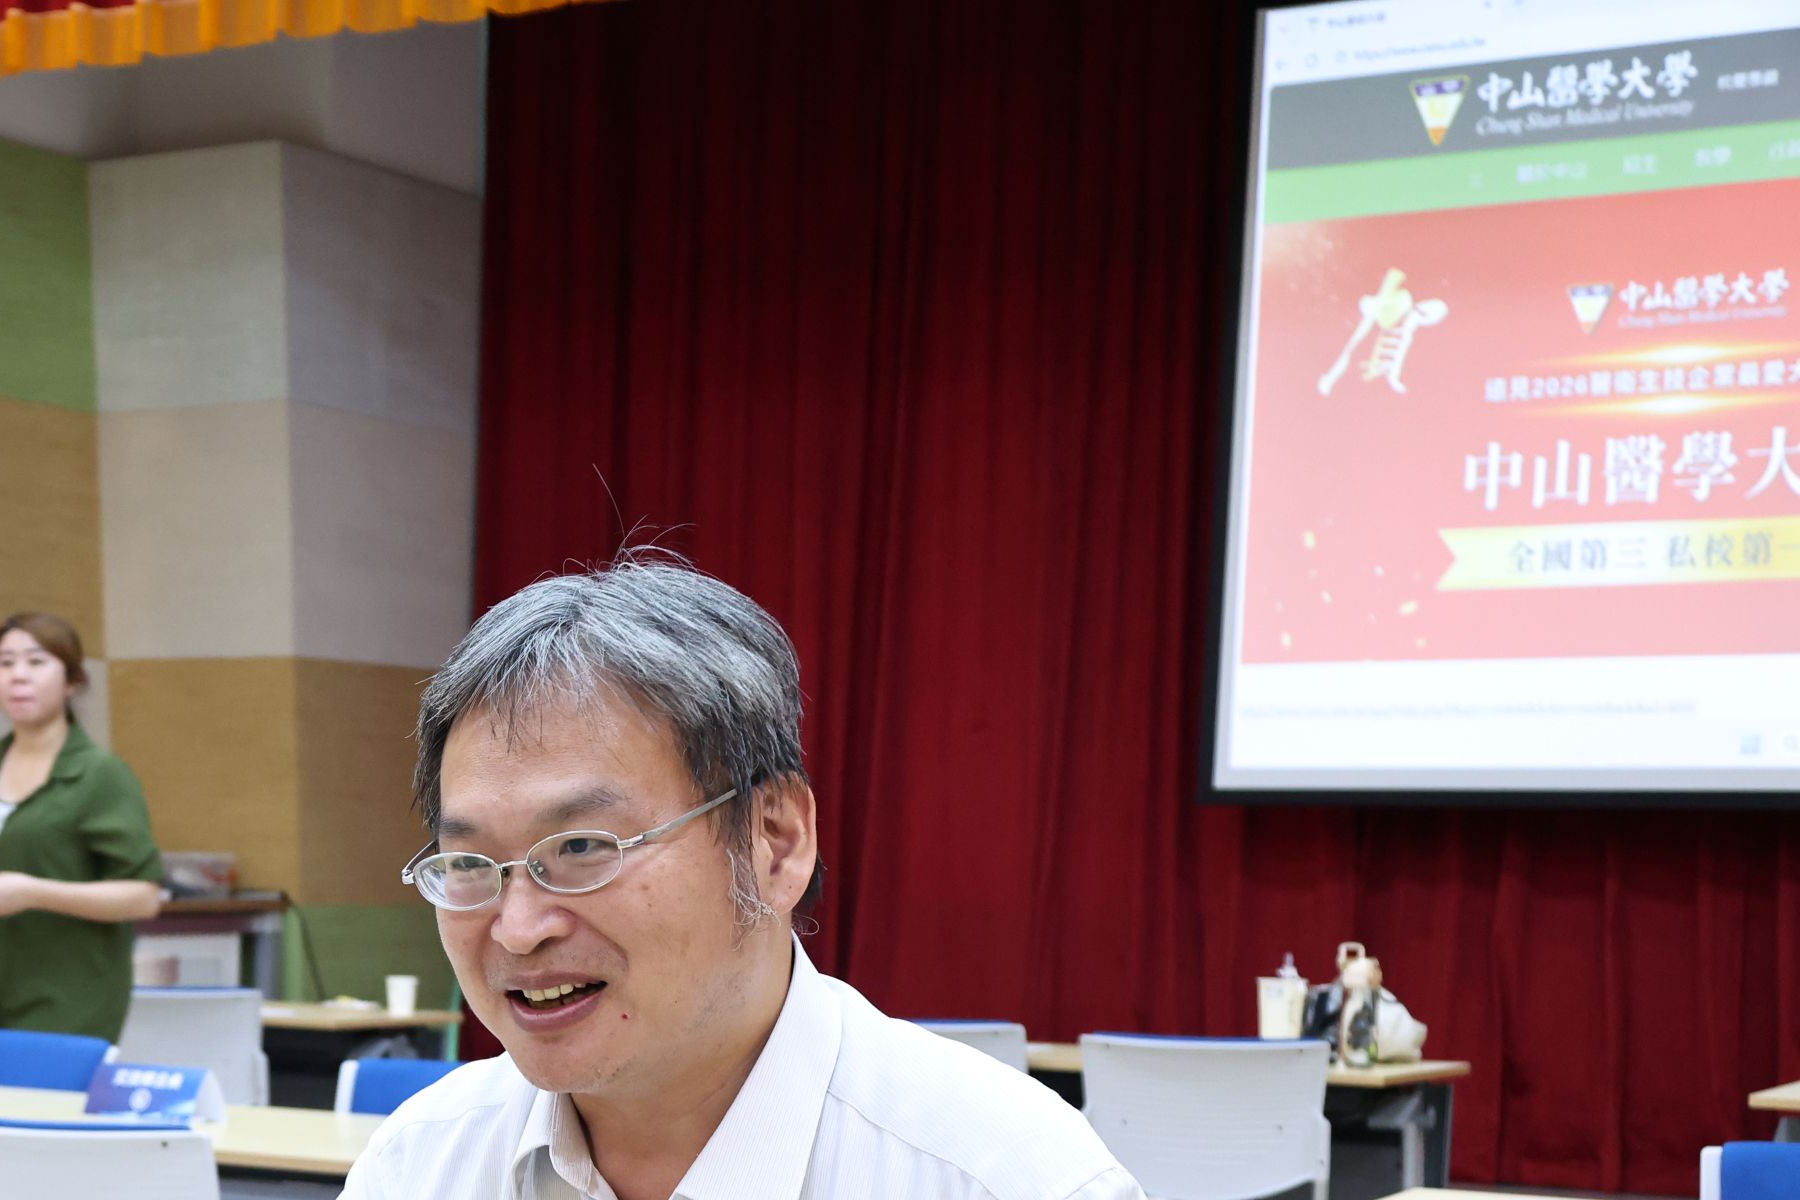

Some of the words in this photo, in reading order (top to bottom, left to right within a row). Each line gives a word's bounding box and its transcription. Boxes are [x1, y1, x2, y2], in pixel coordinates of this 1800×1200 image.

[1477, 50, 1698, 113] 中山醫學大學
[1463, 426, 1800, 511] 中山醫學大
